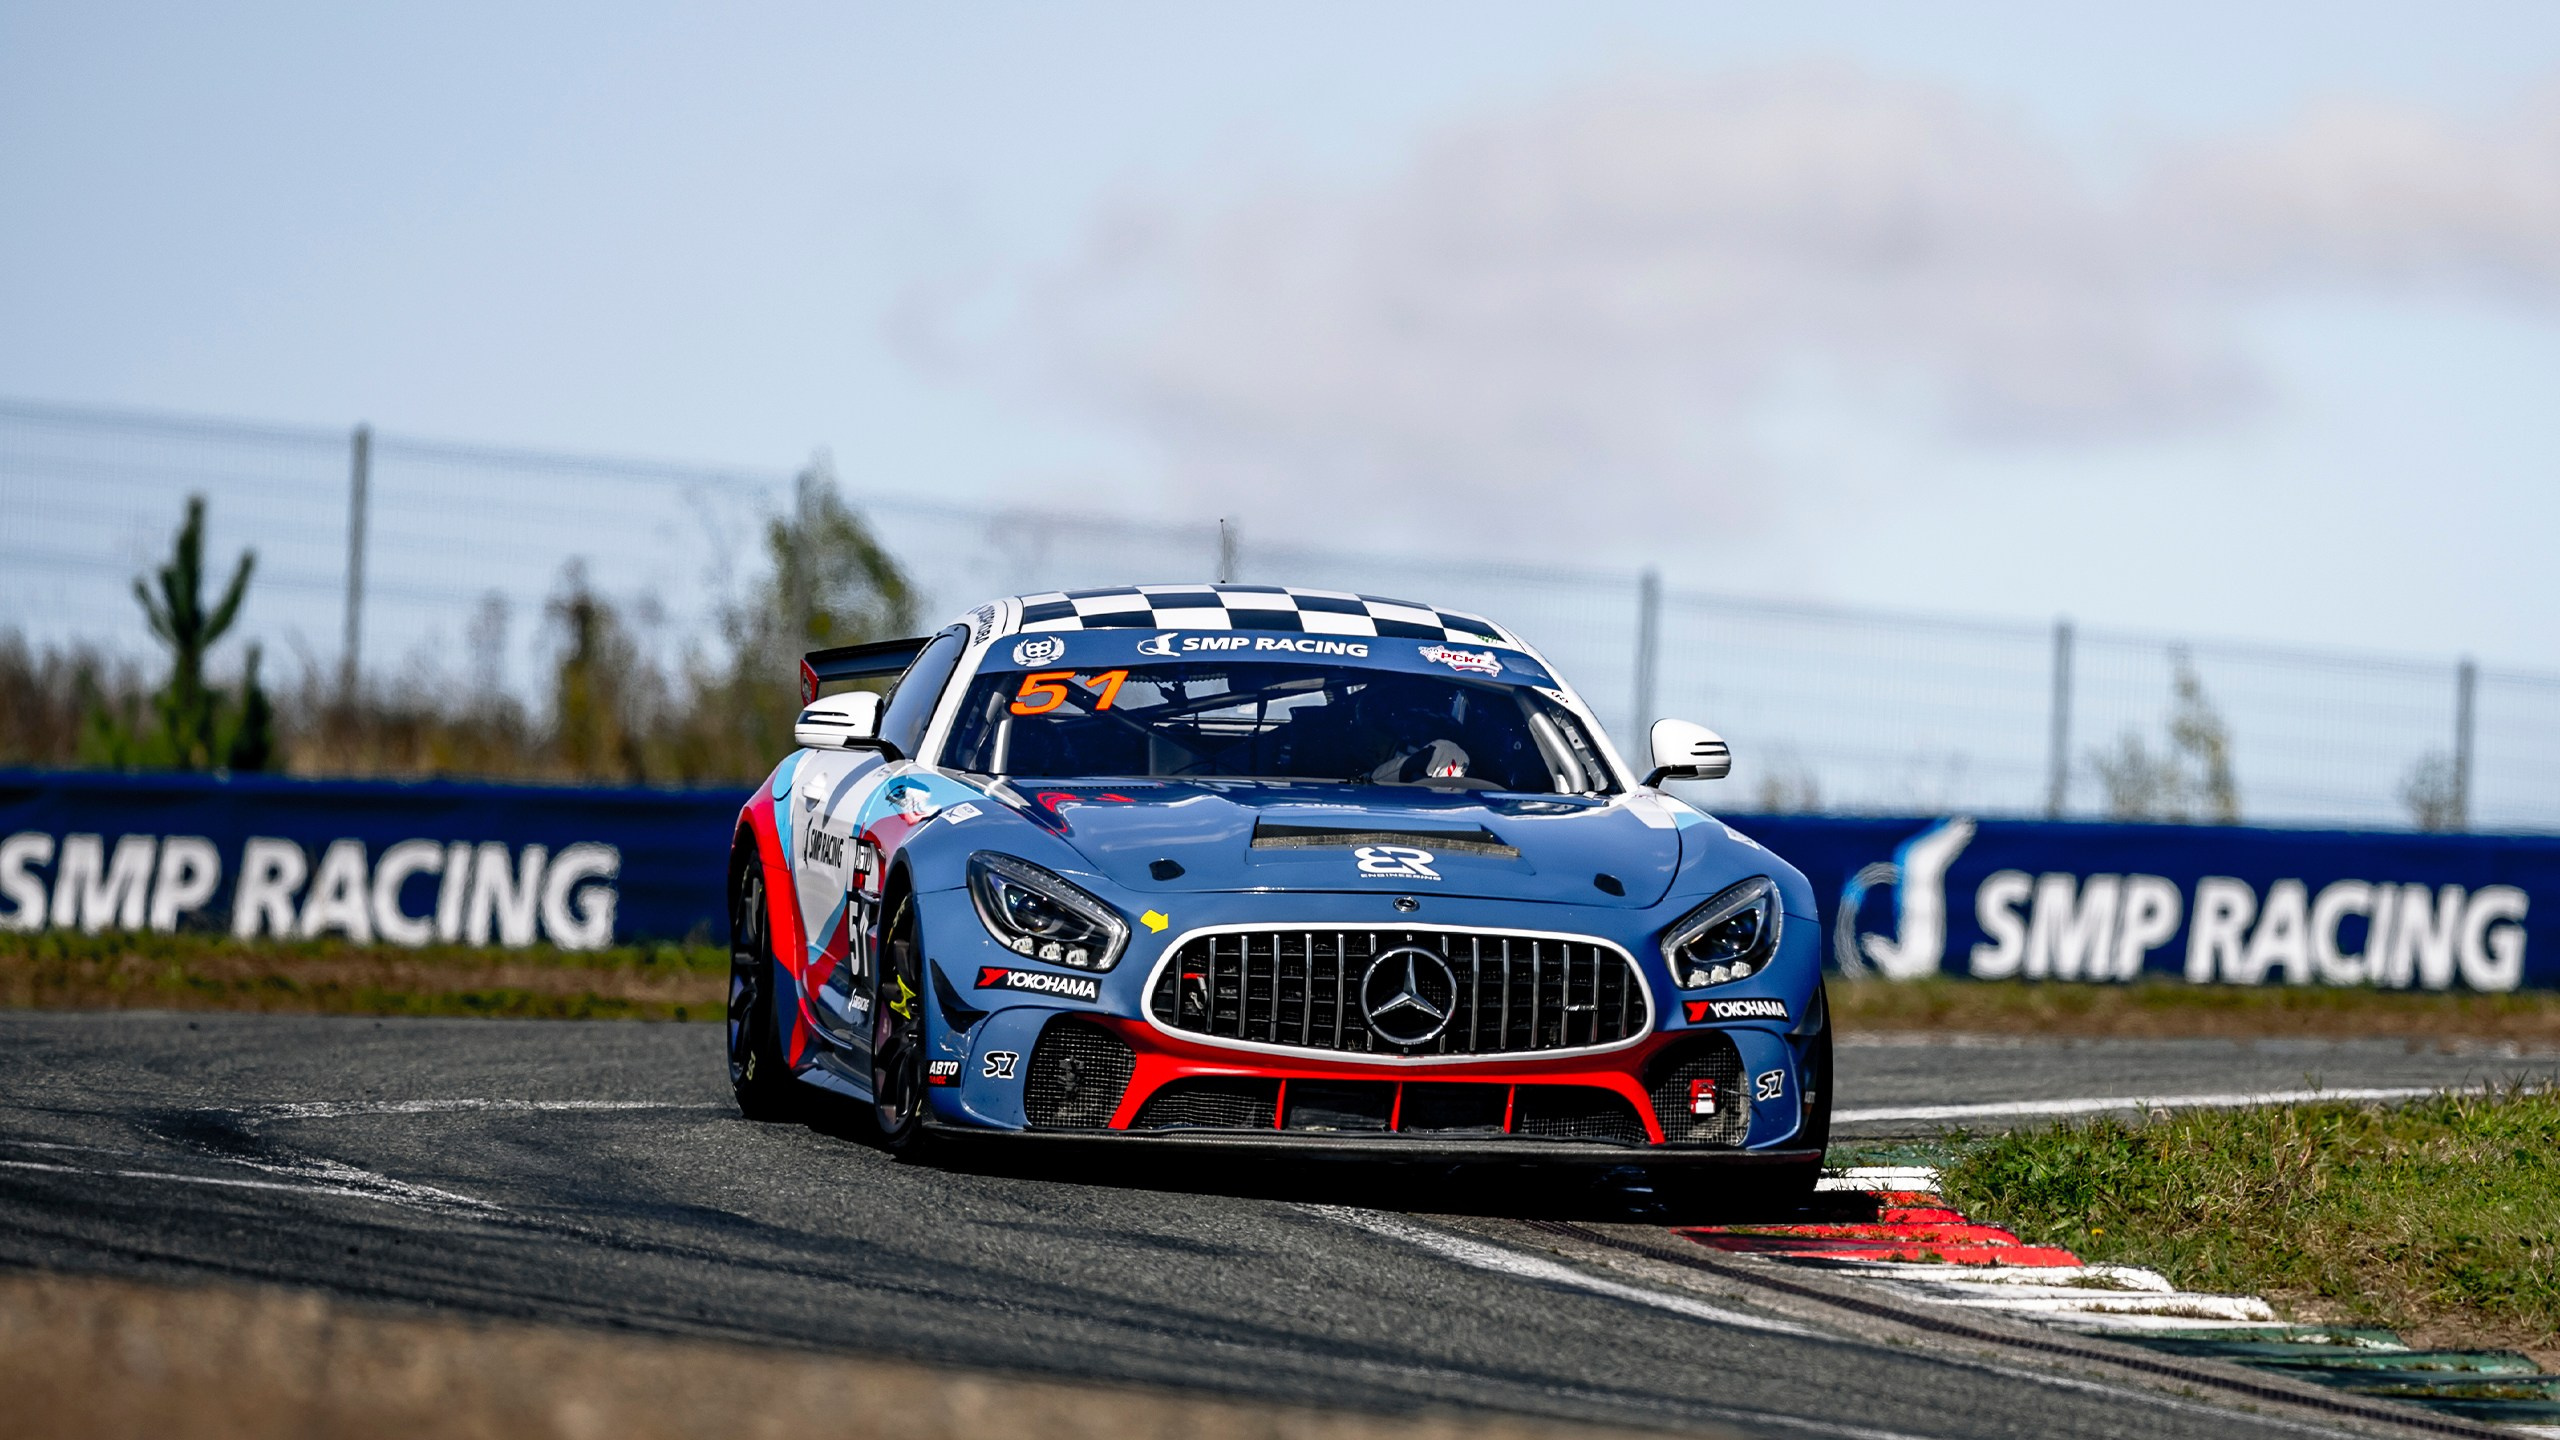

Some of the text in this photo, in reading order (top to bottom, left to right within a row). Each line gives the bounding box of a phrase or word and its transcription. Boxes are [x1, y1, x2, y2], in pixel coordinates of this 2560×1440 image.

[1182, 637, 1369, 658] SMP RACING
[1010, 669, 1129, 716] 51
[0, 832, 621, 950] SMP RACING
[849, 901, 870, 977] 51
[1969, 868, 2530, 992] SMP RACING
[1006, 971, 1096, 999] YOKOHAMA
[1709, 1000, 1788, 1018] YOKOHAMA
[929, 1060, 959, 1076] АВТО
